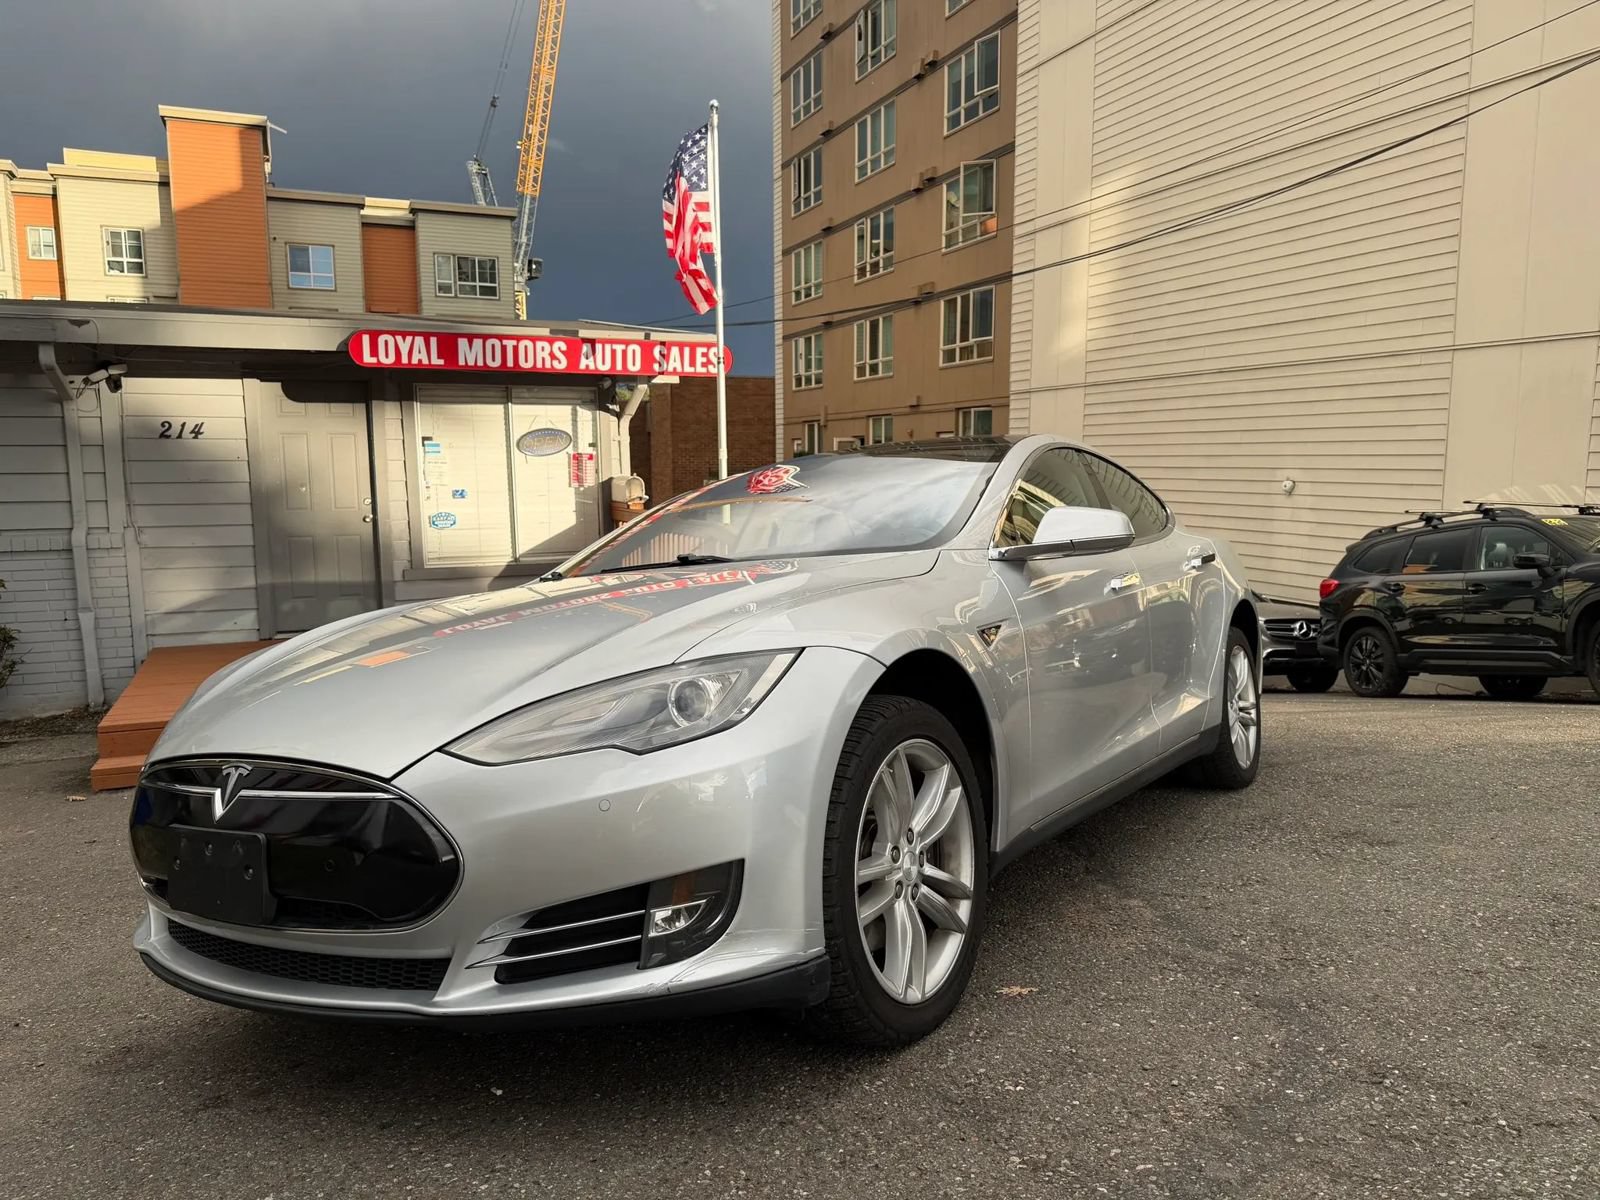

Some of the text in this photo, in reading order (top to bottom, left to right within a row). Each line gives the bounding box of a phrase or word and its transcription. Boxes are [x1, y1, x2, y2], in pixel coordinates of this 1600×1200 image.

[362, 334, 719, 374] LOYAL MOTORS AUTO SALES
[159, 420, 205, 439] 214
[523, 435, 567, 450] OPEN
